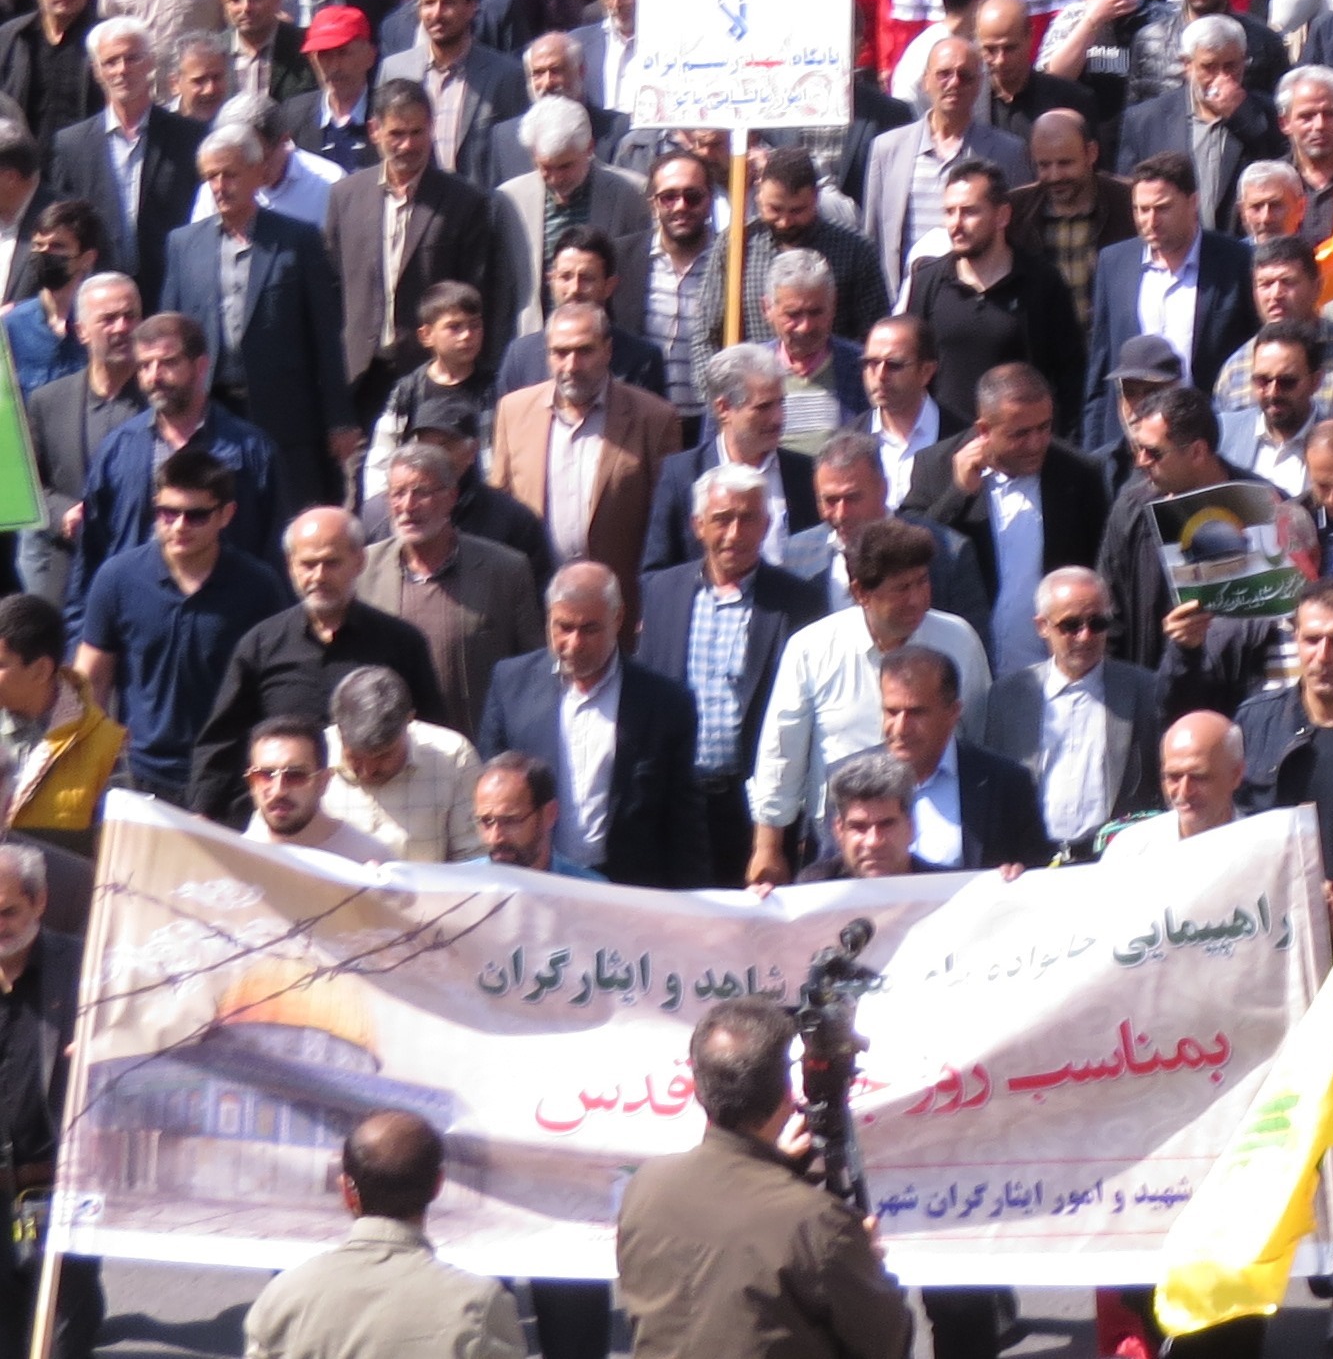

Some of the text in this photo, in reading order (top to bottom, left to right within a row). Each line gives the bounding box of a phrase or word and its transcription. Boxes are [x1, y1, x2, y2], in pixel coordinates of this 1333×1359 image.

[792, 47, 839, 67] پایگاه
[1113, 891, 1297, 968] راهپیمایی
[477, 945, 653, 1006] ایثارگران
[659, 971, 684, 1011] و
[693, 963, 789, 1003] شاهد
[535, 1057, 697, 1133] قدس
[904, 1059, 992, 1115] روز
[927, 1180, 1044, 1219] ایثارگران
[1051, 1178, 1102, 1216] امور
[1114, 1184, 1126, 1213] و
[1134, 1175, 1194, 1213] شهید
